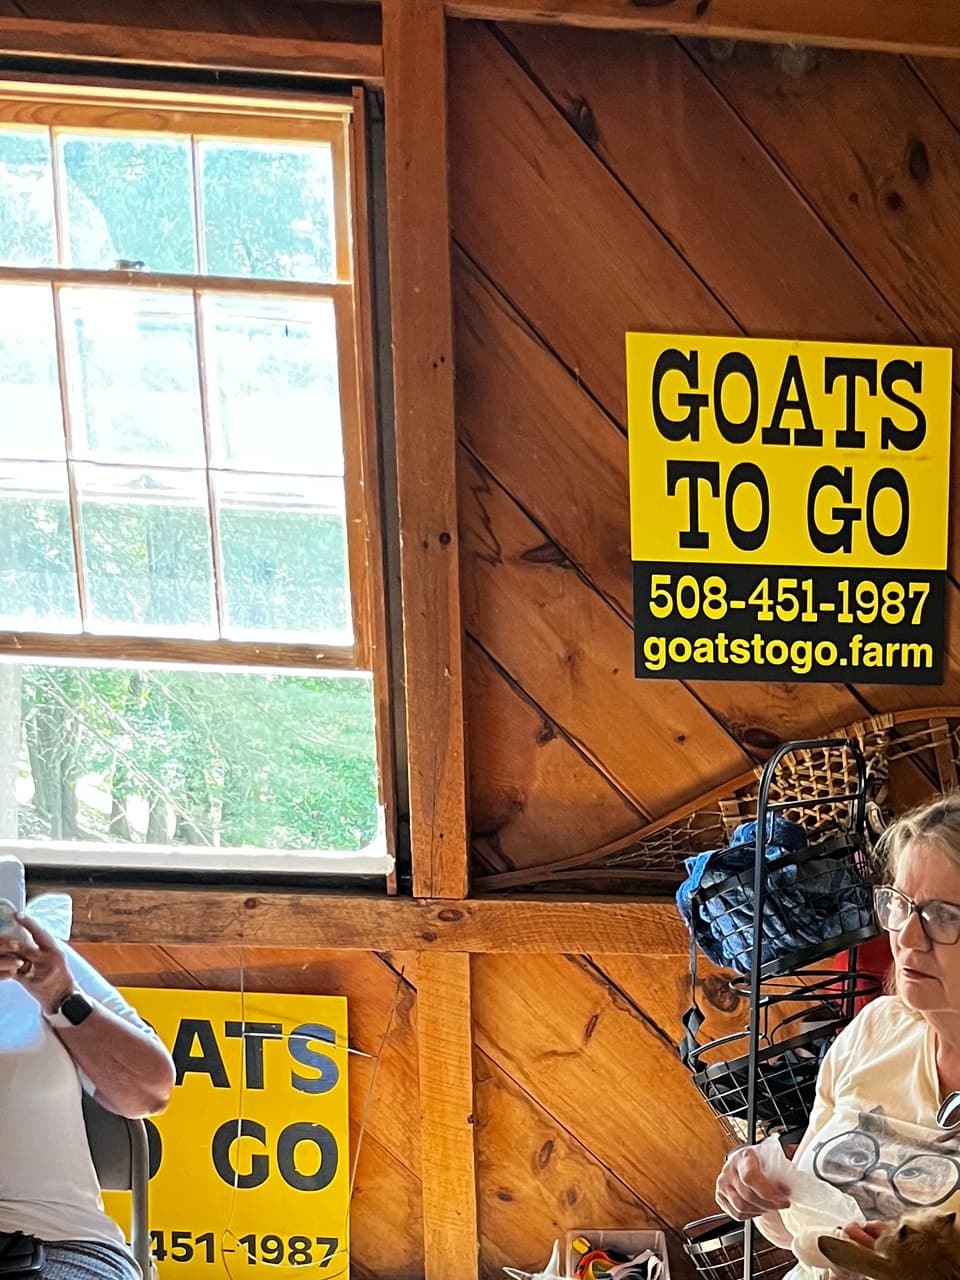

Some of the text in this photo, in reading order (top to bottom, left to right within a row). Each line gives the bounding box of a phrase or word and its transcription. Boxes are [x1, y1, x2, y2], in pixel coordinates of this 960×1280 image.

[651, 348, 927, 451] GOATS
[666, 459, 910, 556] TO GO
[649, 574, 930, 625] 508-451-1987
[643, 632, 934, 674] goatstogo.farm
[141, 1018, 339, 1095] ATS
[211, 1118, 339, 1192] GO
[149, 1229, 339, 1268] 451-1987
